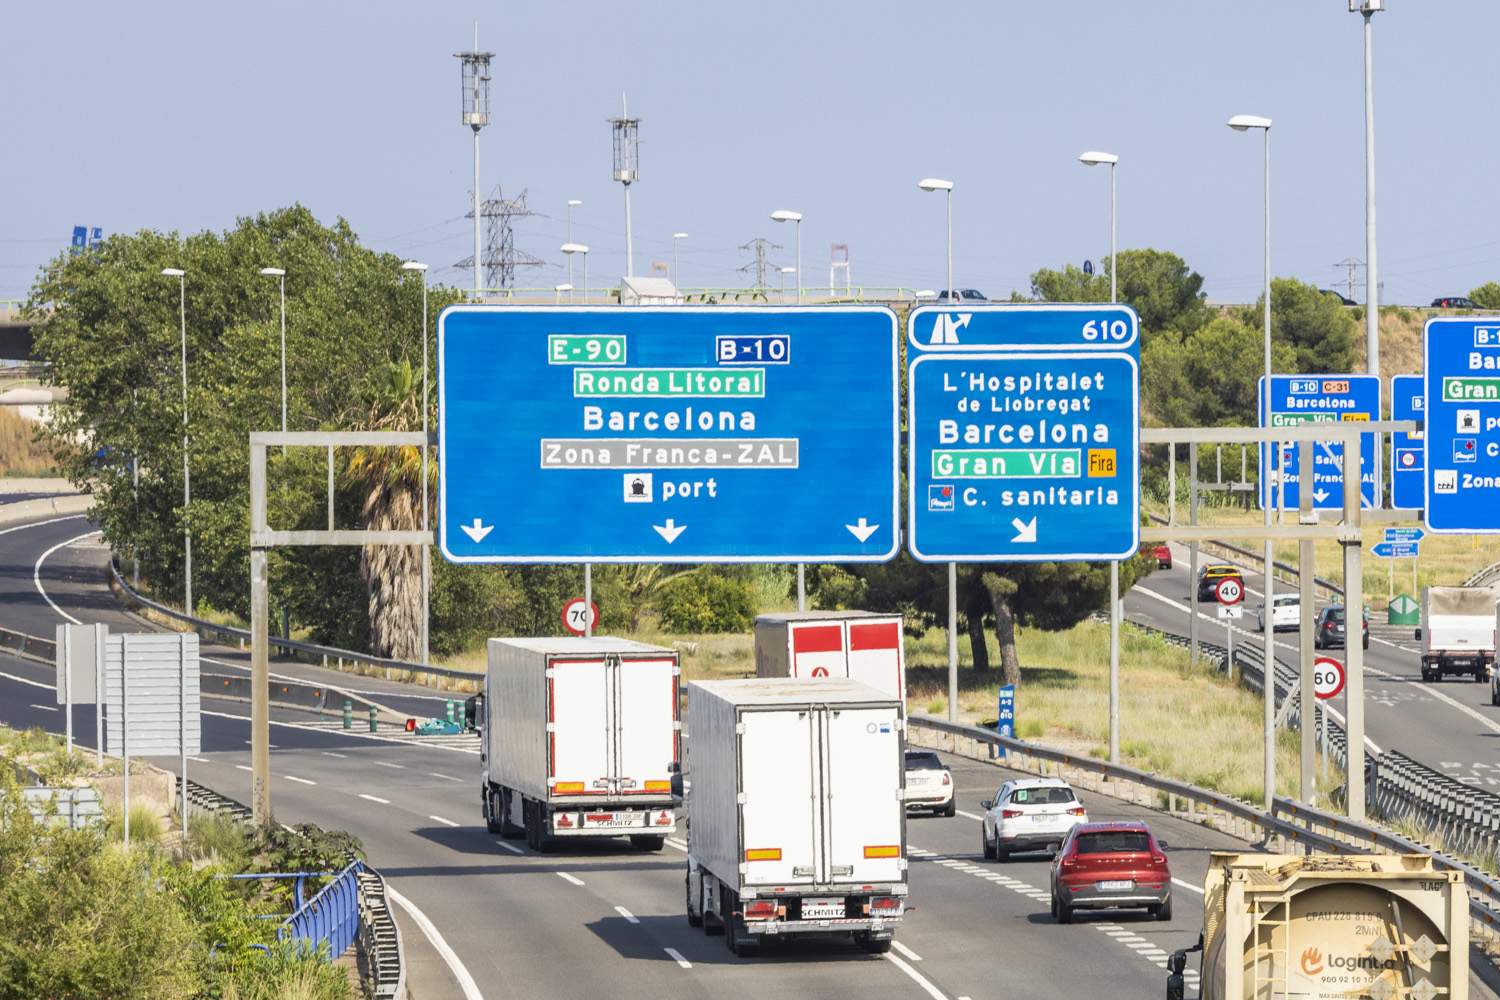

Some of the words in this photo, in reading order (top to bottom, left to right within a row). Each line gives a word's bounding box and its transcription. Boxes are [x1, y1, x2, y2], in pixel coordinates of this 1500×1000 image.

[1082, 320, 1127, 340] 610
[553, 339, 621, 360] E-90
[720, 340, 786, 360] B-10
[579, 373, 660, 393] Ronda
[669, 372, 760, 393] Litoral
[1292, 382, 1316, 391] B-10
[1324, 383, 1348, 391] C-31
[1449, 382, 1497, 398] Gran
[958, 398, 980, 412] de
[991, 396, 1091, 415] Llobregat
[1286, 396, 1355, 408] Barcelona
[584, 406, 756, 431] Barcelona
[939, 420, 1109, 444] Barcelona
[546, 445, 611, 464] Zona
[626, 443, 793, 464] Franca-ZAL
[937, 454, 1006, 475] Gran
[1091, 454, 1113, 472] Fira
[1283, 474, 1301, 483] Zon
[663, 479, 717, 501] port
[963, 487, 987, 506] C.
[1221, 586, 1238, 596] 40
[1314, 671, 1336, 685] 60
[1321, 976, 1337, 984] 900
[1339, 976, 1349, 984] 92
[1352, 976, 1361, 984] 10
[1364, 976, 1374, 984] 10
